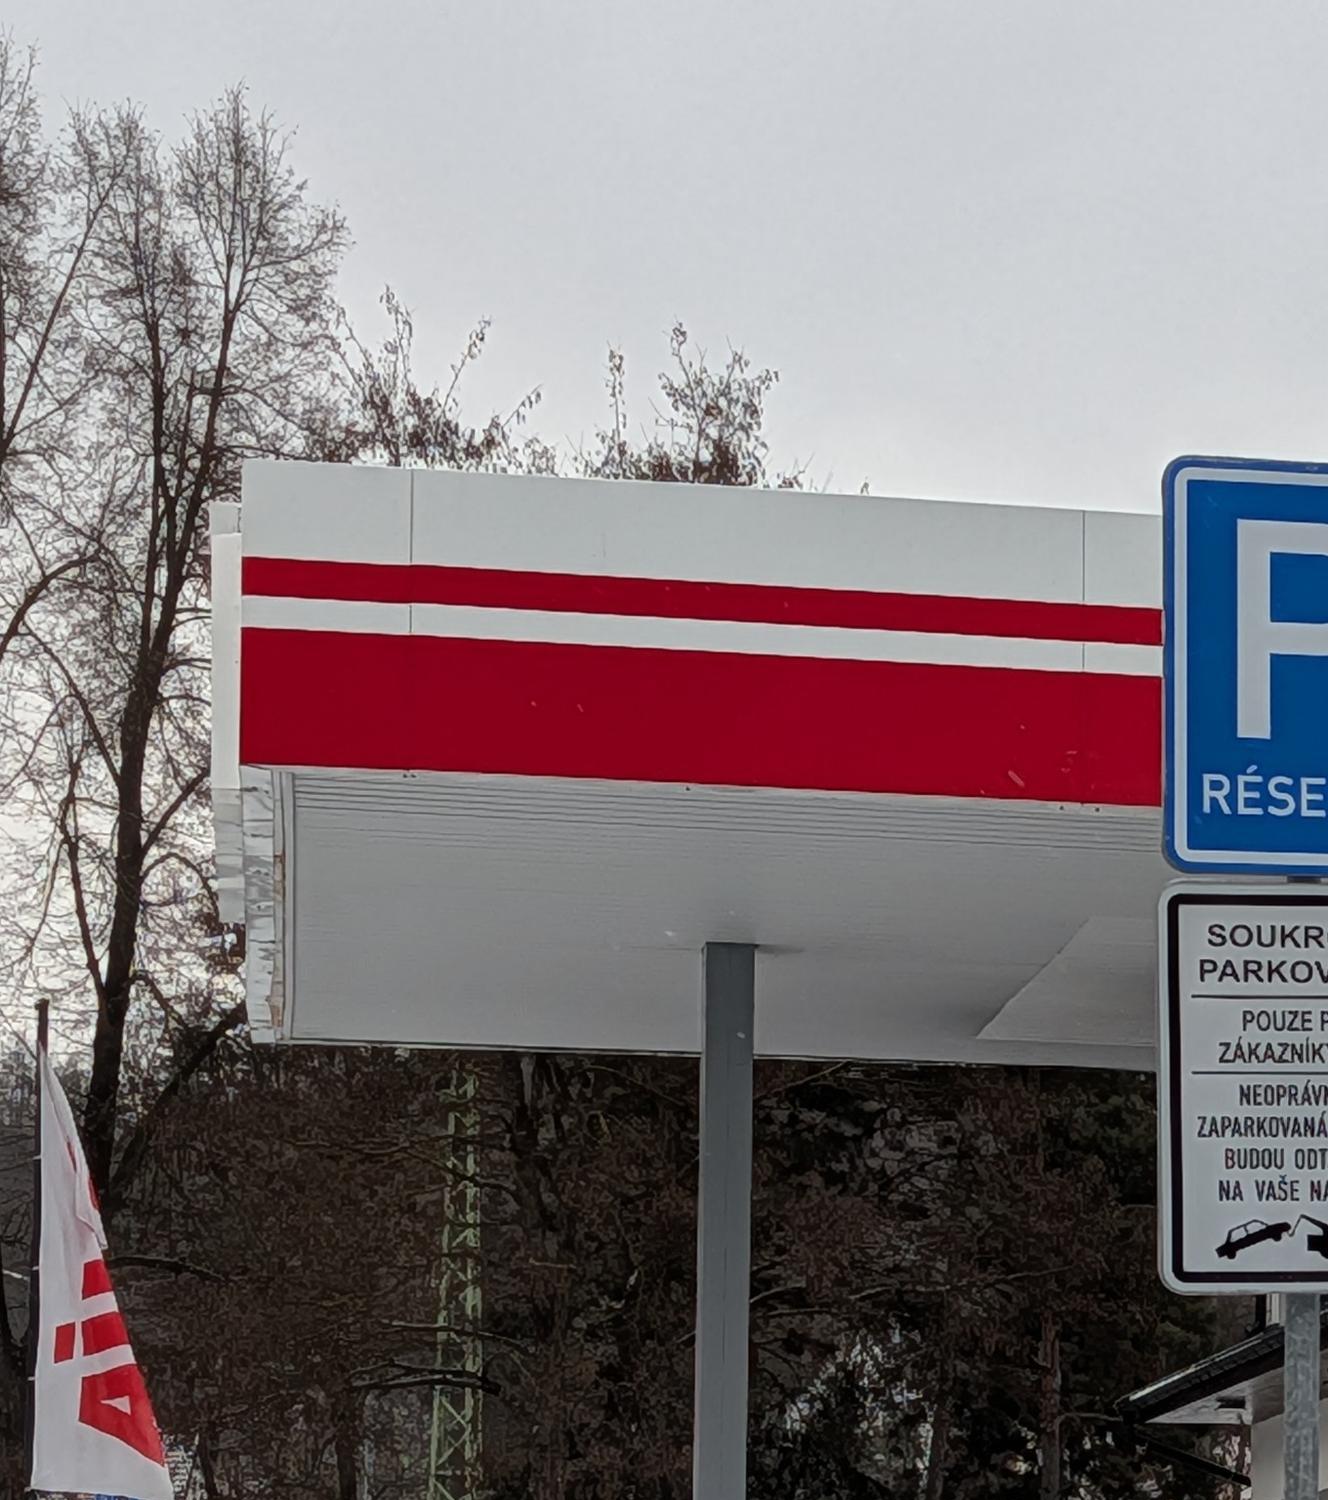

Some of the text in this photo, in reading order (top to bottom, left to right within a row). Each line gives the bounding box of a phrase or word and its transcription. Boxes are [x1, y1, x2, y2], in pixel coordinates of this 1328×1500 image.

[1242, 1010, 1313, 1032] POUZE
[1196, 1110, 1328, 1139] ZAPARKOVANÁ
[1224, 1148, 1285, 1170] BUDOU
[1218, 1179, 1244, 1202] NA
[1254, 1174, 1301, 1202] VAŠE
